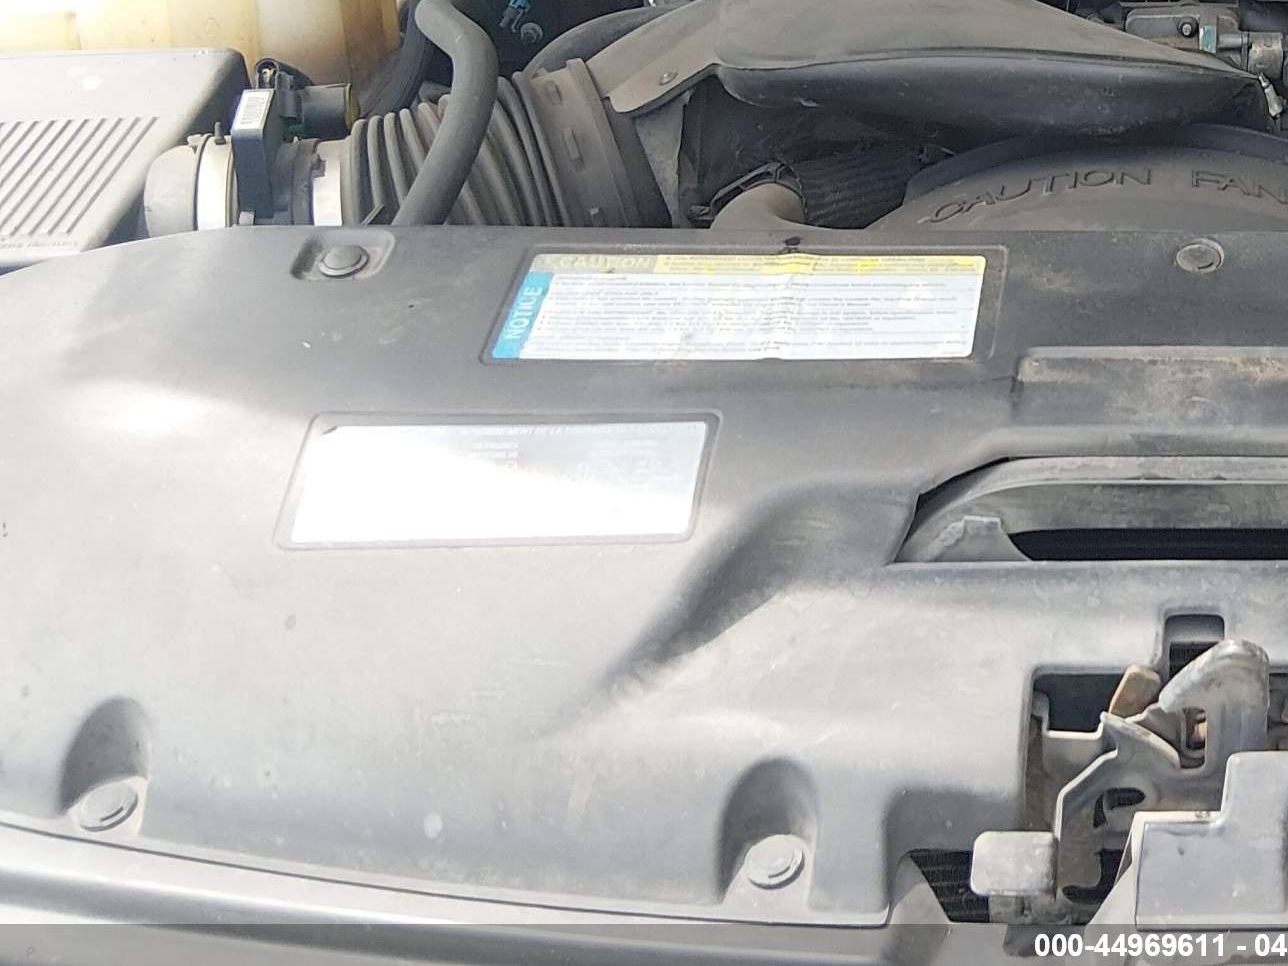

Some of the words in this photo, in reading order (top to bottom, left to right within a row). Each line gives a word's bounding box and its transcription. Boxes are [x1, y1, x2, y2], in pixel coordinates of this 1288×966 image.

[929, 166, 1152, 223] CAUTION
[1191, 169, 1288, 204] FAN
[559, 256, 651, 269] CAUTION
[504, 285, 543, 341] NOTICE
